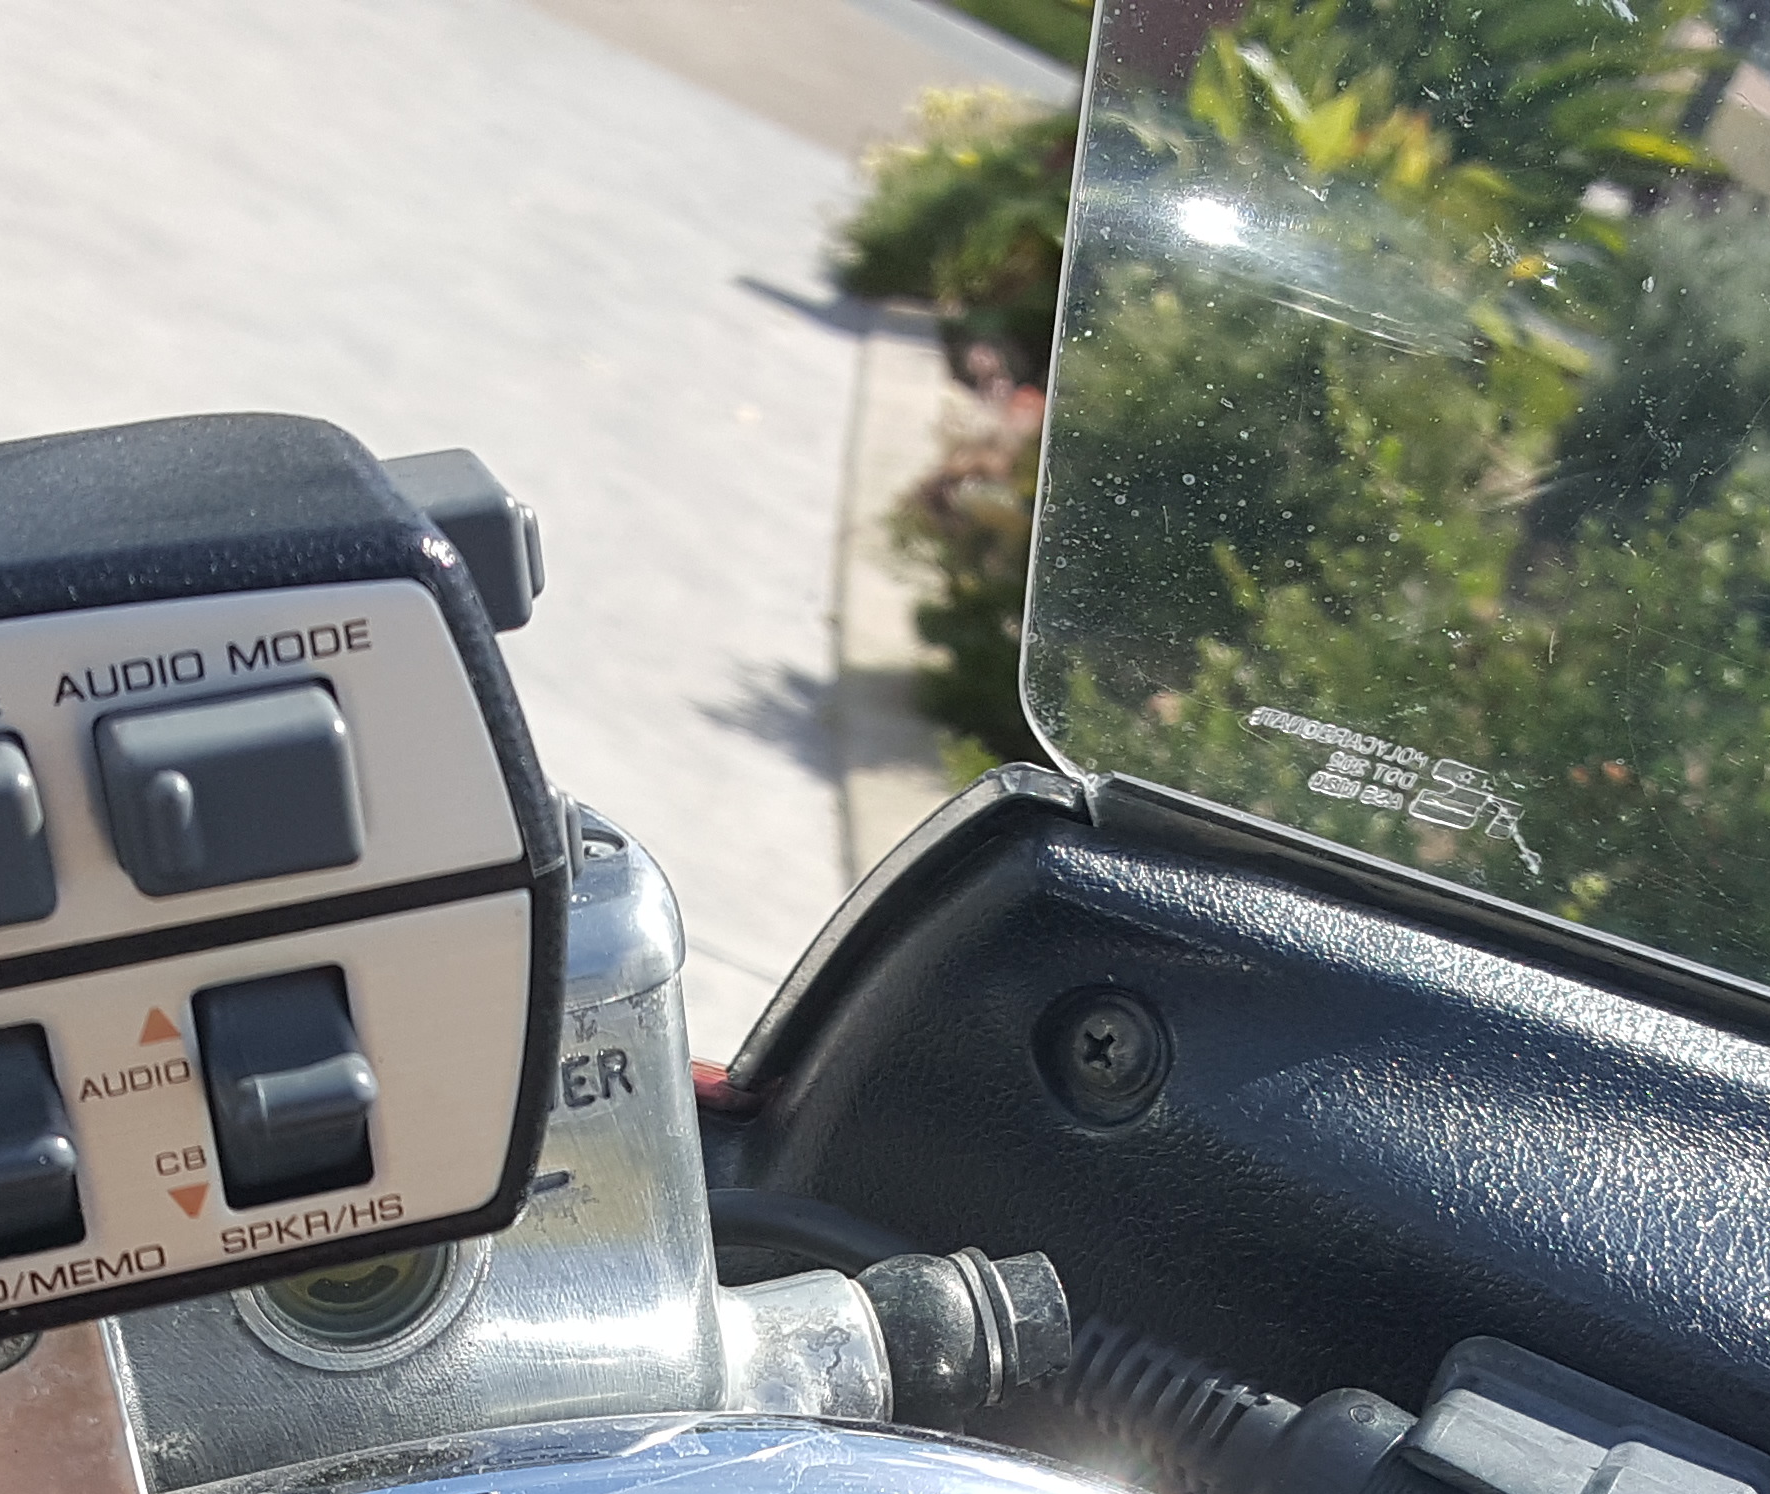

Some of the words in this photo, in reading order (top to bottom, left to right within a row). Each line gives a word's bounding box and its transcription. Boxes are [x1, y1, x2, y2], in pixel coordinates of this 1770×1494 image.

[54, 649, 206, 706] AUDIO
[227, 618, 373, 673] MODE
[78, 1058, 192, 1103] AUDIO
[155, 1144, 207, 1177] CB
[221, 1193, 404, 1256] SPKR/HS
